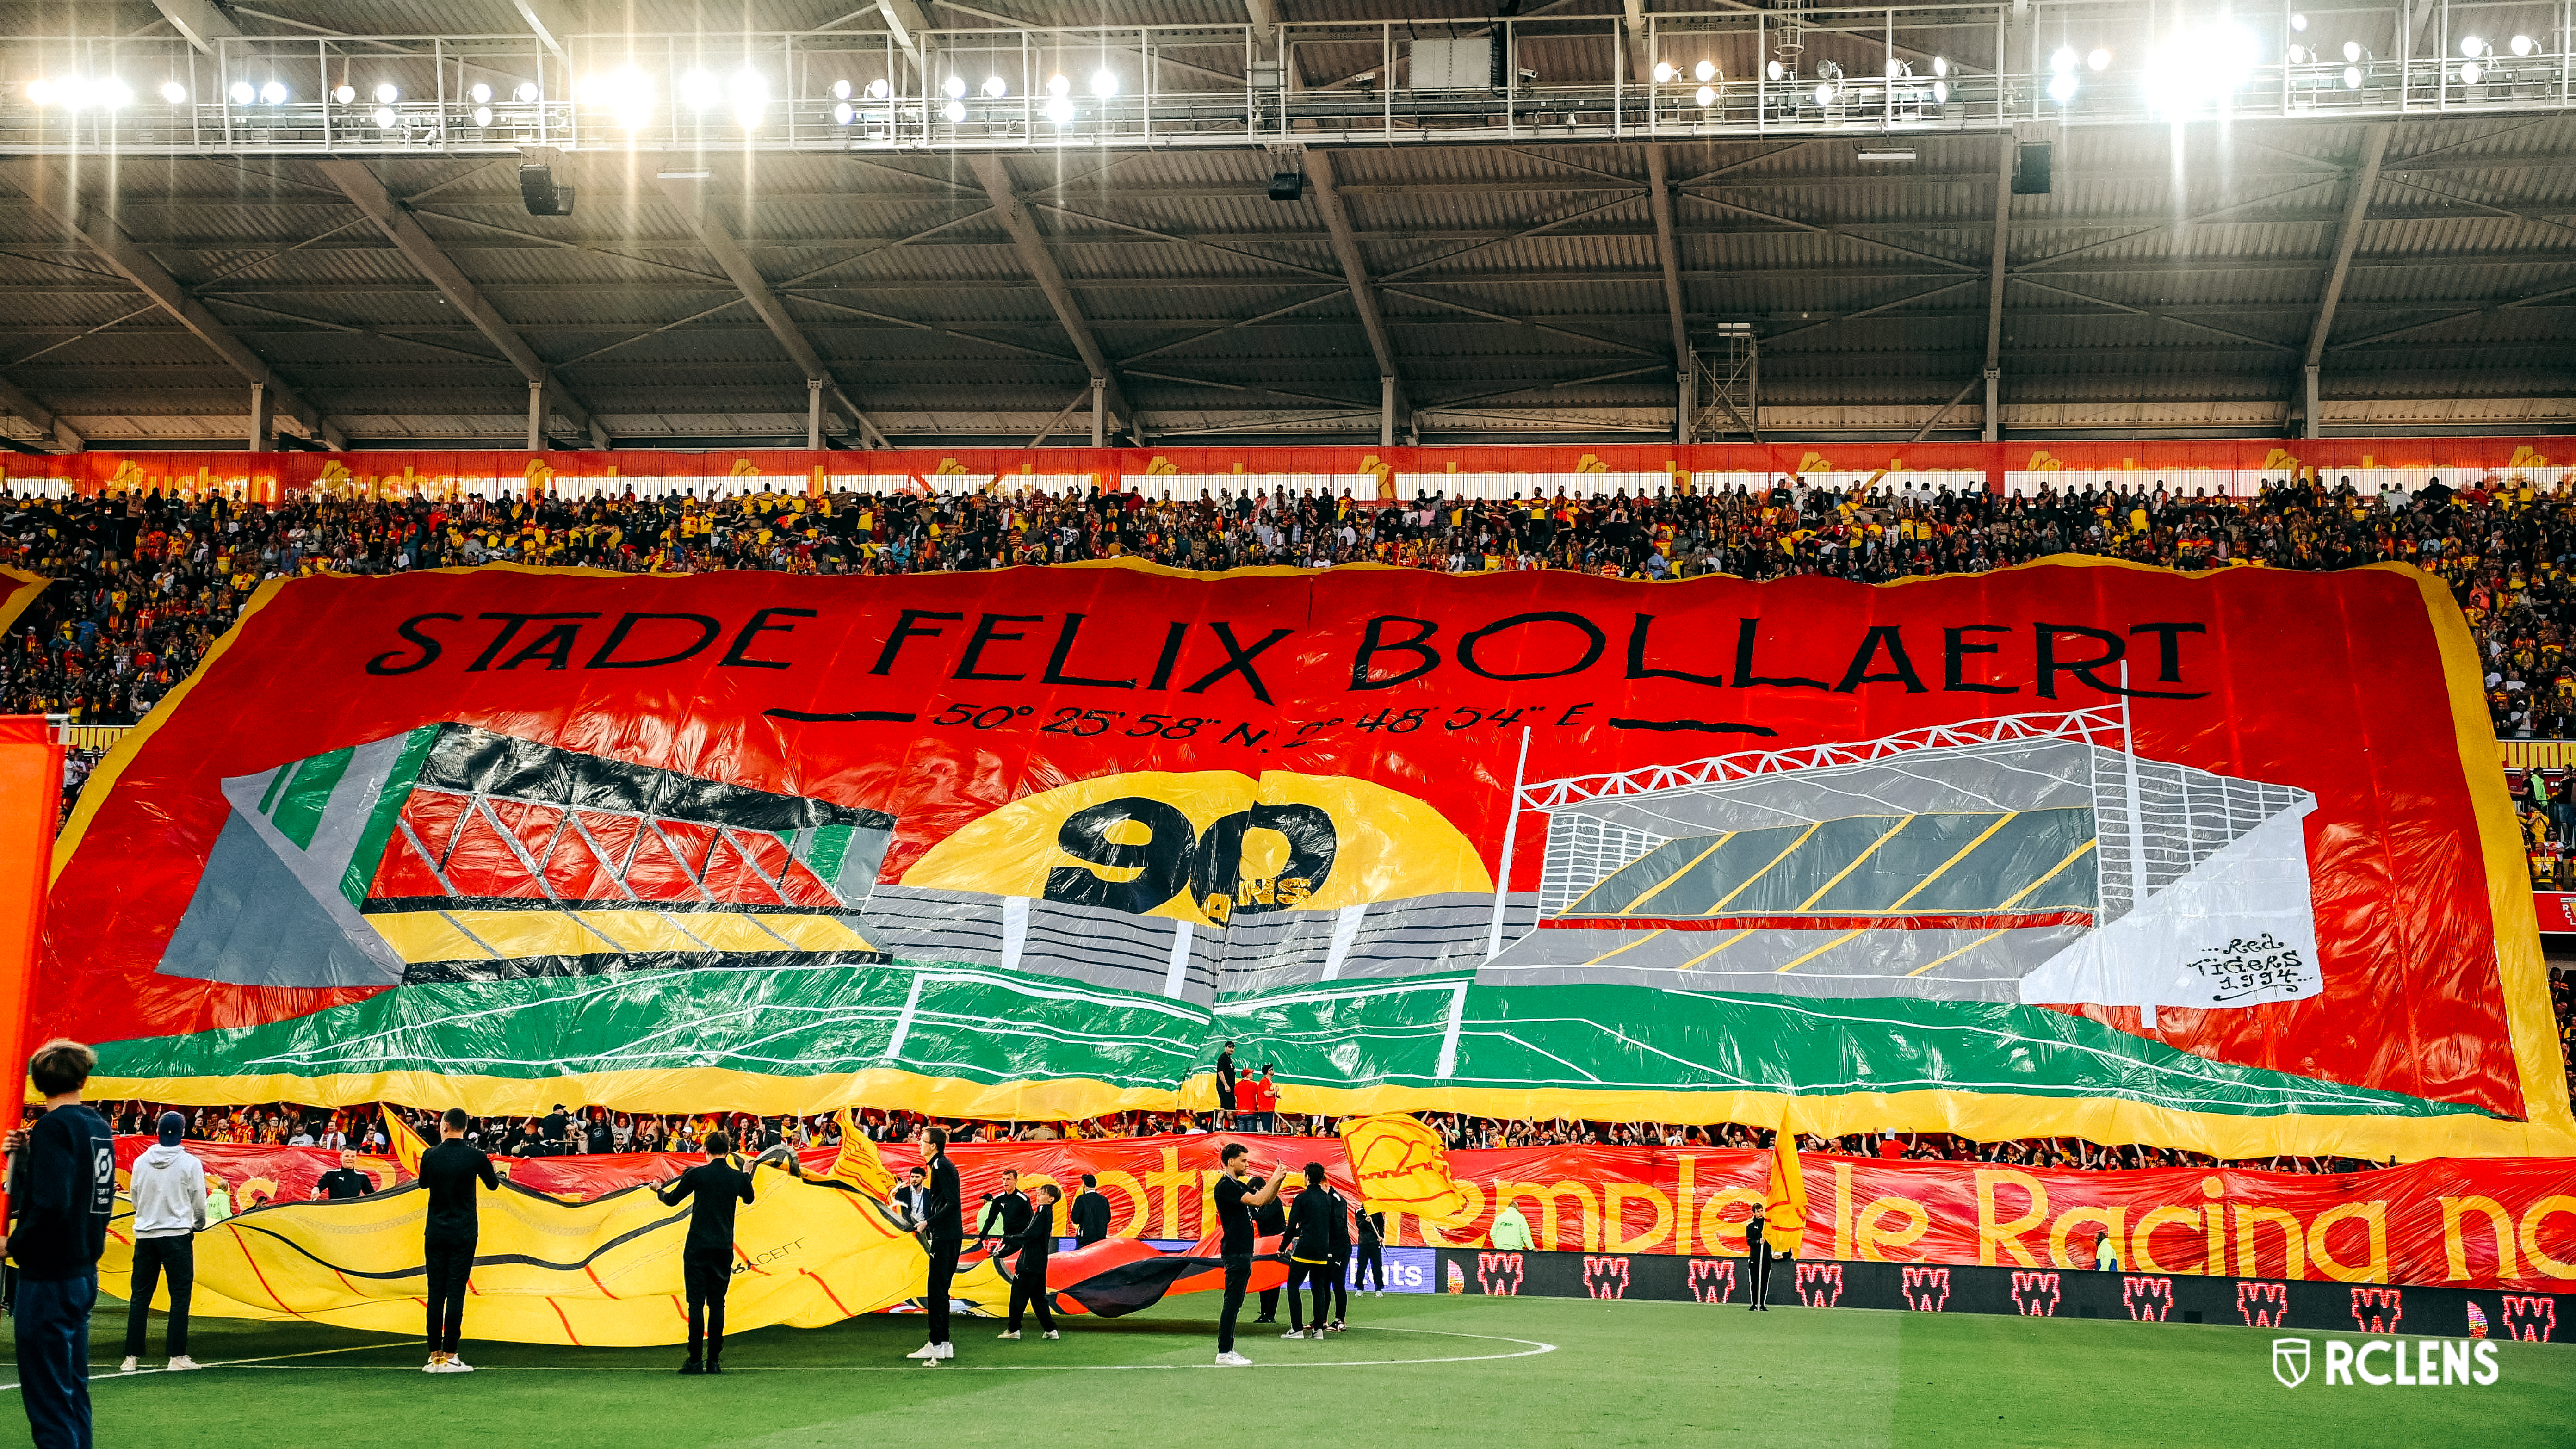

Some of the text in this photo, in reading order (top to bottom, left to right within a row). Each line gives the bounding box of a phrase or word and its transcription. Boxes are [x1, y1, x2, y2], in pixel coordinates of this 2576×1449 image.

[365, 607, 2210, 706] STADE FELIX BOLLAERT
[65, 727, 134, 750] PUM
[1555, 702, 1594, 726] E
[1042, 797, 1336, 928] 90
[1833, 1162, 1929, 1264] le
